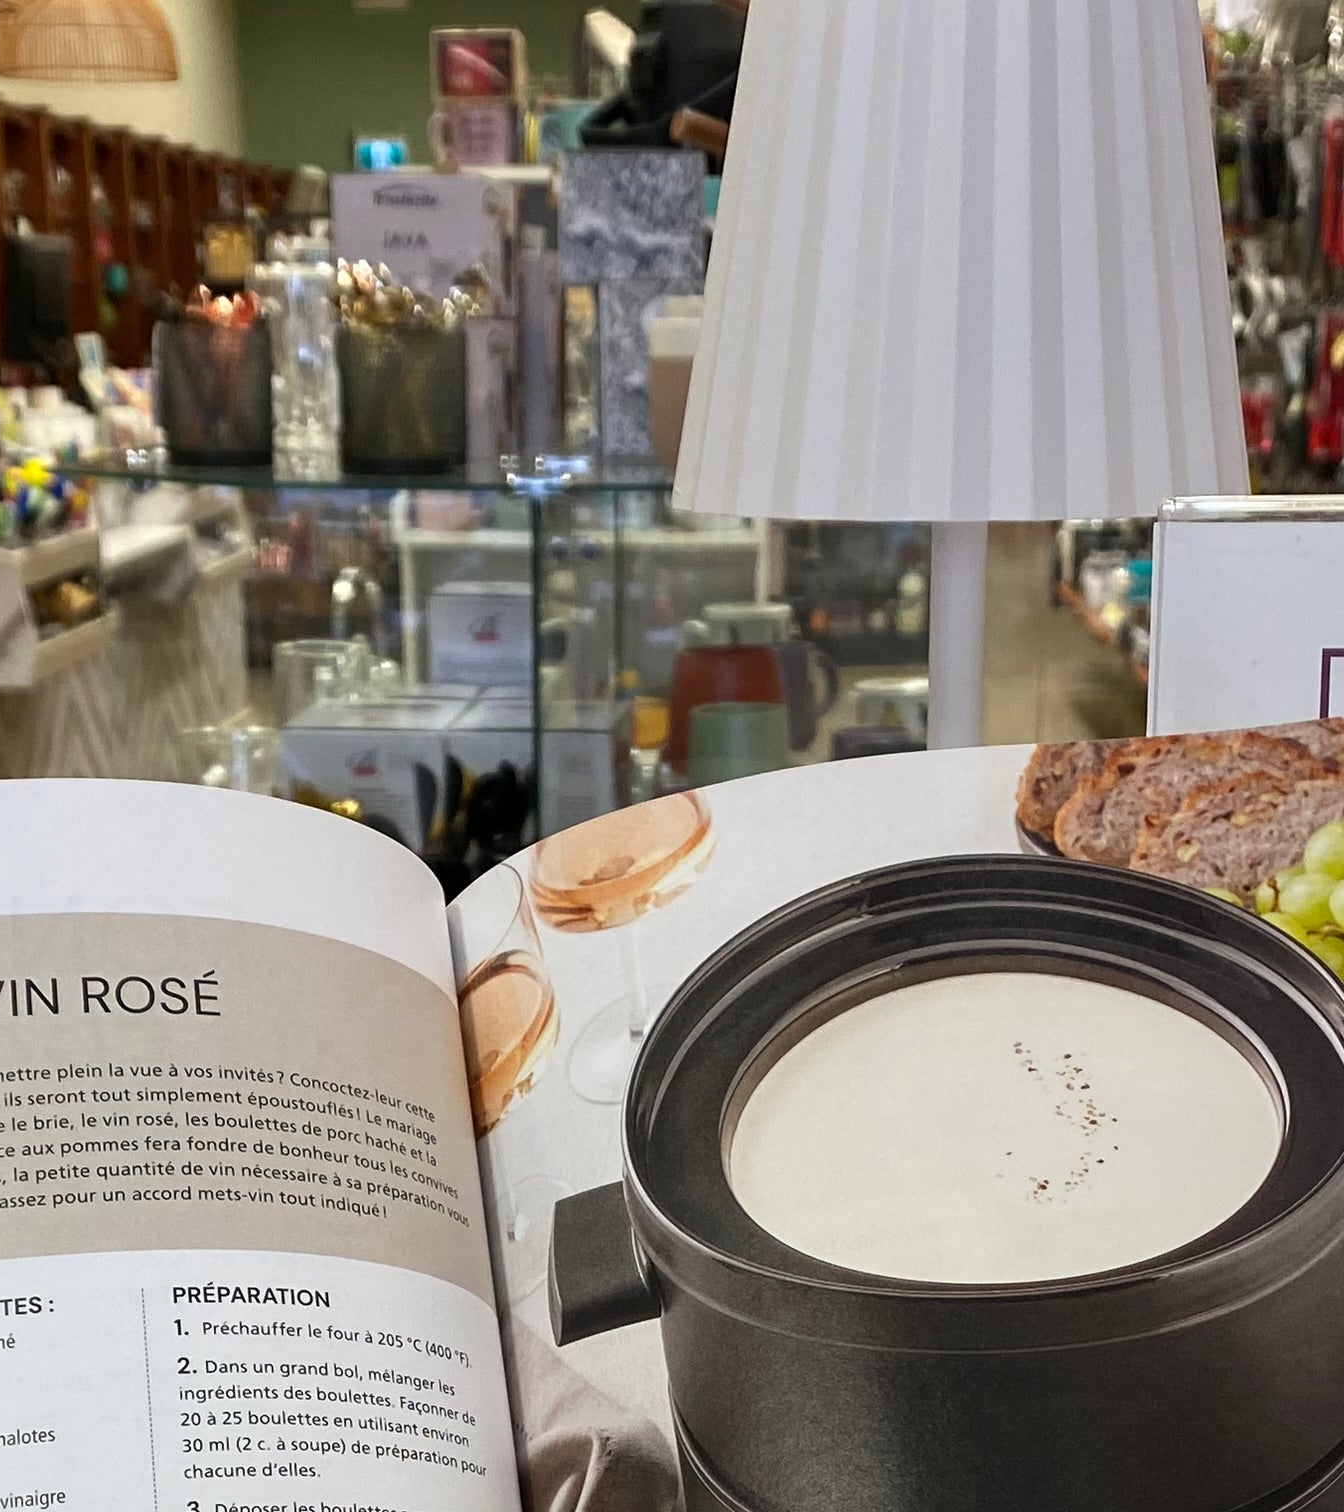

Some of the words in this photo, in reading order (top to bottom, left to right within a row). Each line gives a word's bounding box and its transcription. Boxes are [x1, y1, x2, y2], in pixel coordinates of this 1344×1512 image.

[81, 969, 221, 1017] ROSÉ
[52, 1191, 97, 1209] pour
[102, 1190, 126, 1202] un
[132, 1185, 192, 1201] accord
[198, 1187, 274, 1204] mets-vin
[278, 1191, 316, 1208] tout
[172, 1281, 331, 1308] PRÉPARATION
[173, 1318, 190, 1336] 1.
[202, 1320, 303, 1337] Préchauffer
[307, 1323, 322, 1339] le
[326, 1324, 360, 1342] four
[364, 1330, 374, 1344] à
[377, 1331, 404, 1349] 205
[425, 1340, 452, 1361] (400
